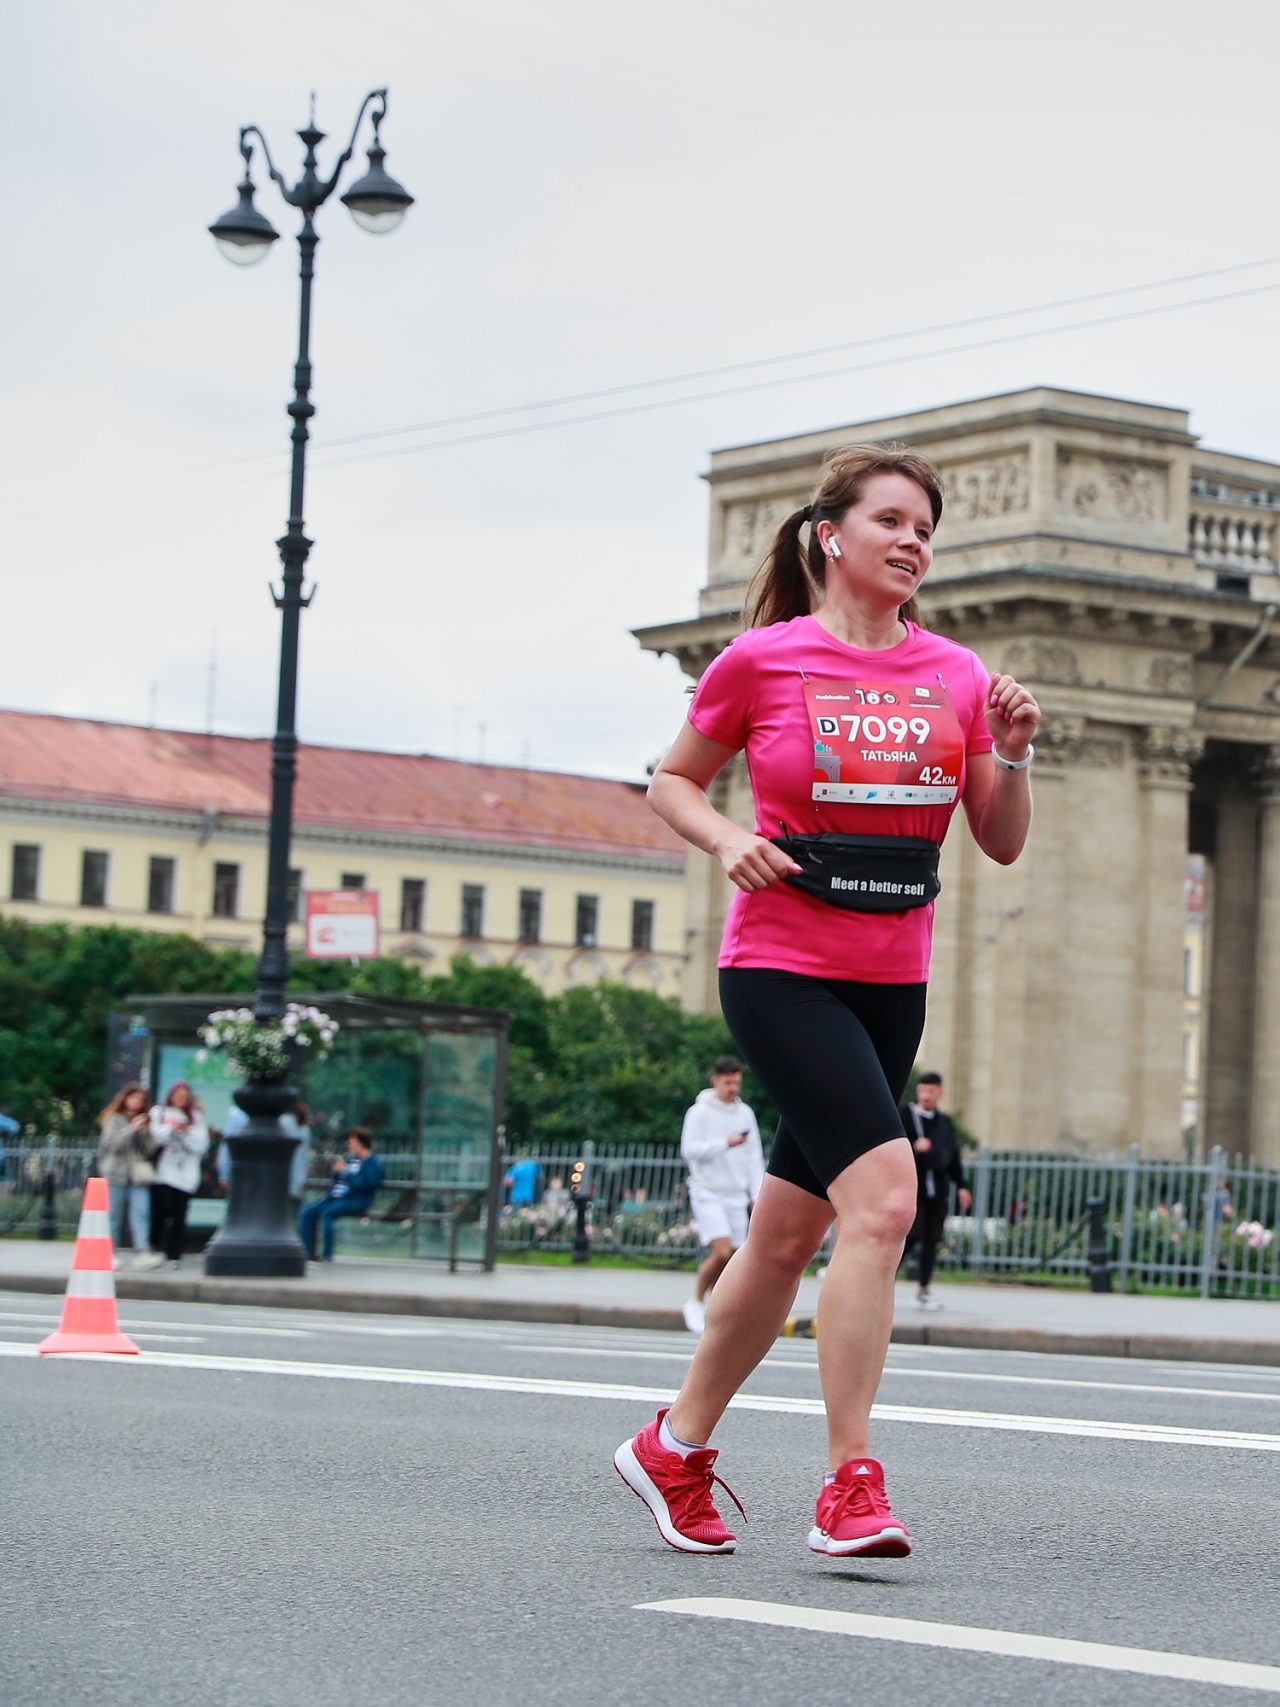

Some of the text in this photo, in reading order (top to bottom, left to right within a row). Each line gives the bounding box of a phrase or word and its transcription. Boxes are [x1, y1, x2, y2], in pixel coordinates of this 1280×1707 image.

[820, 715, 931, 744] D 7099
[860, 750, 918, 763] ТАТЬЯНА
[831, 877, 925, 896] Meet a better self
